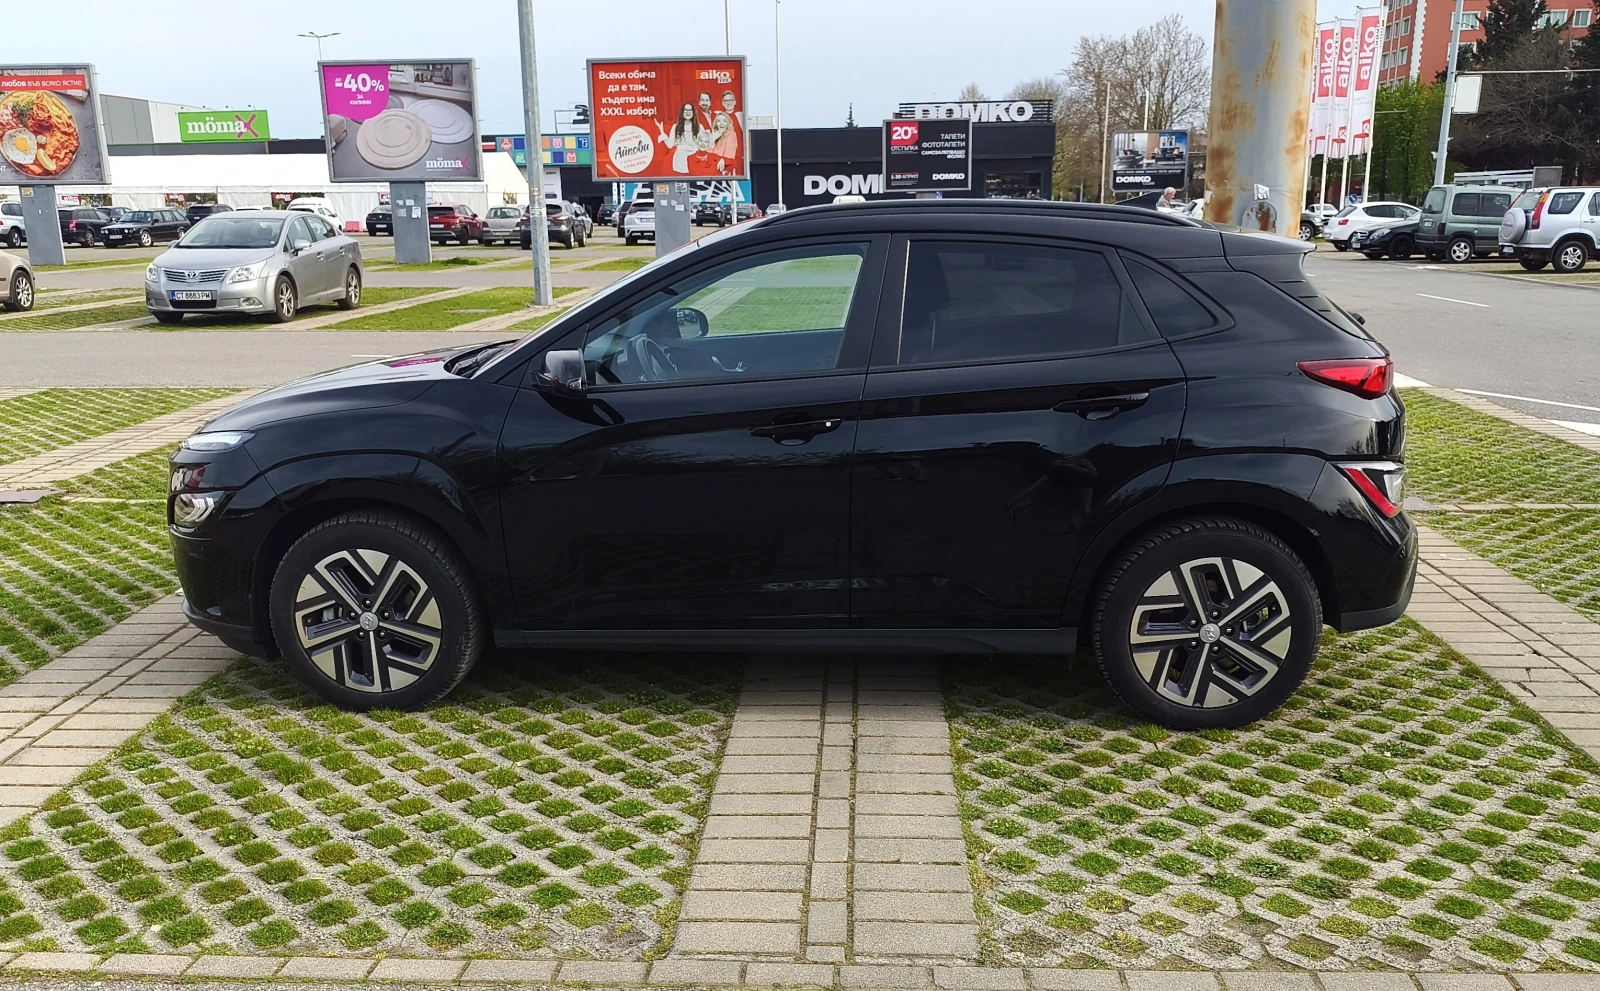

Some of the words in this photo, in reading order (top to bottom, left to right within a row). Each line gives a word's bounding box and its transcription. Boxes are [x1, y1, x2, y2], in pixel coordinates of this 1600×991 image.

[1360, 26, 1375, 80] aiko
[1336, 37, 1353, 88] aiko
[598, 70, 626, 79] Всеки
[628, 70, 656, 79] обича
[700, 69, 730, 80] aiko
[1, 79, 26, 87] любов
[607, 84, 620, 93] да
[628, 84, 648, 92] там,
[602, 96, 636, 105] където
[626, 106, 657, 117] избор!
[914, 101, 1034, 123] DOMKO
[892, 126, 918, 140] 20%
[803, 174, 884, 195] DOM
[1115, 175, 1152, 184] DOMKO
